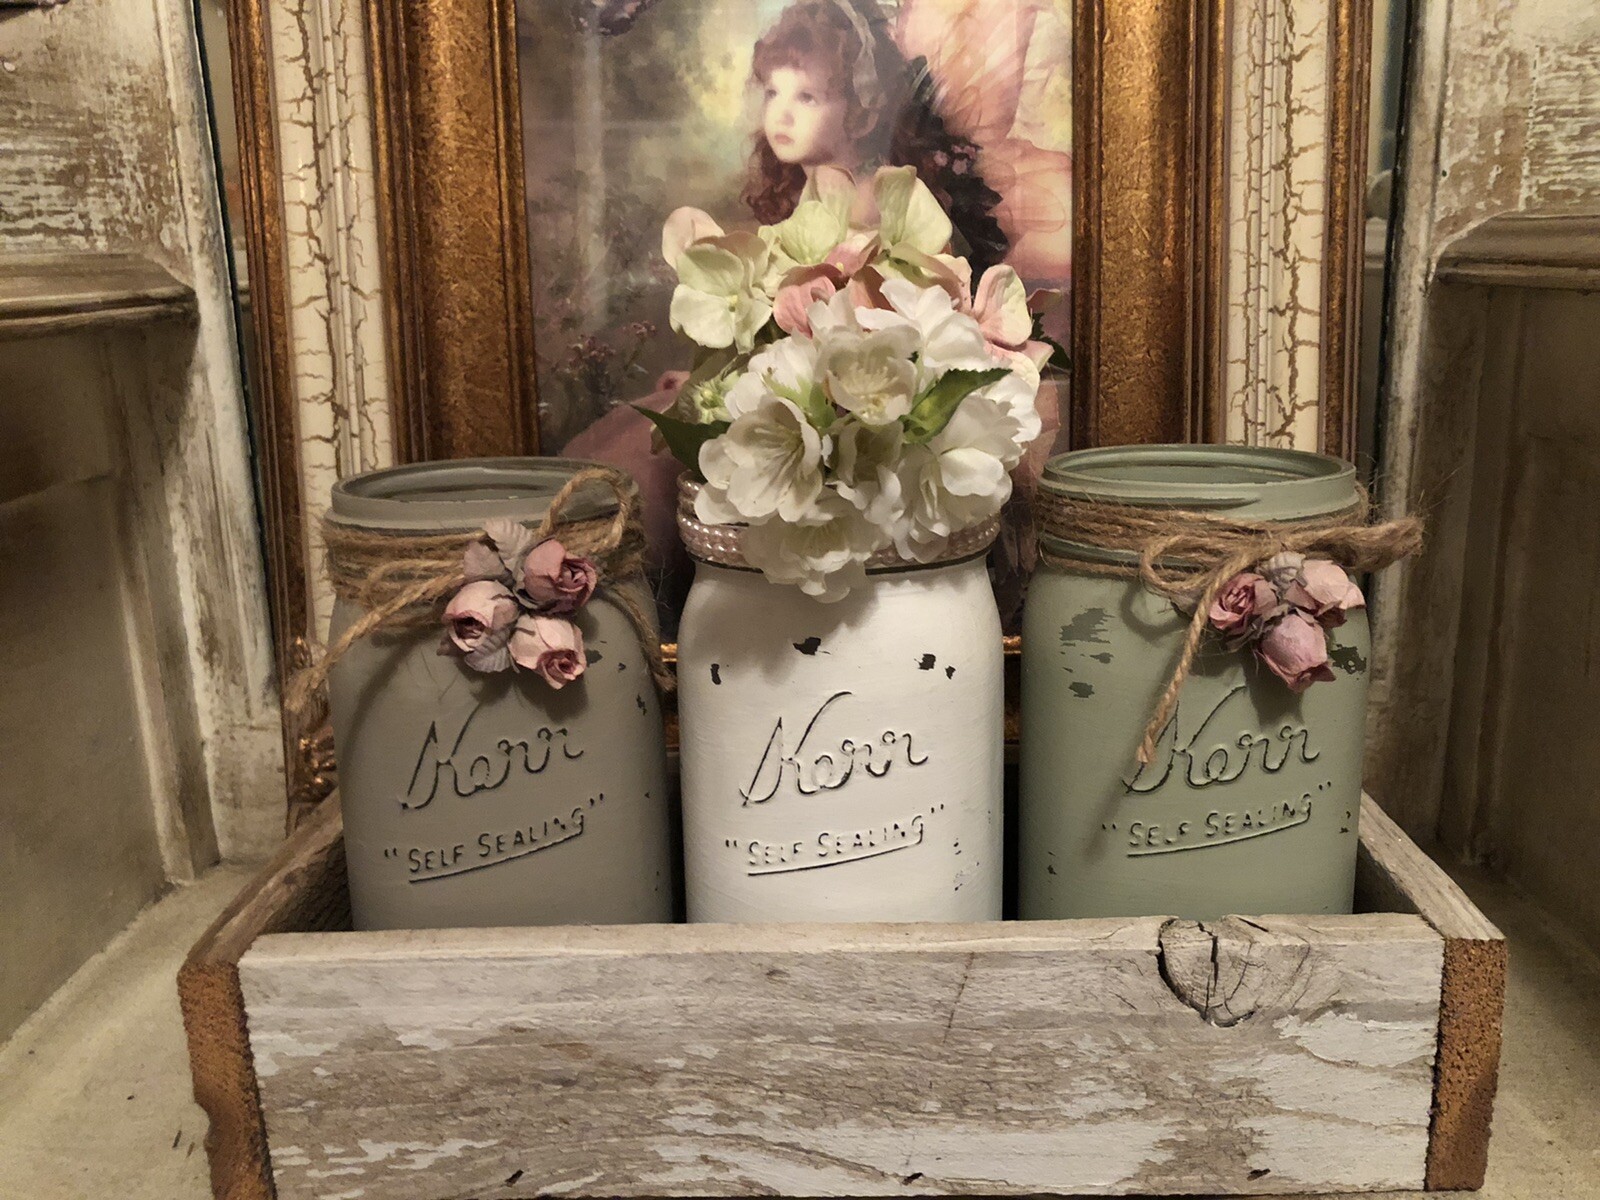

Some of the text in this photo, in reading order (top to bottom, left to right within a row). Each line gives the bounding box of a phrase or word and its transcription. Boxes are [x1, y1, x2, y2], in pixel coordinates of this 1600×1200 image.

[399, 692, 584, 810] Kerr
[738, 690, 929, 807] Kerr
[1121, 685, 1320, 794] Kerr
